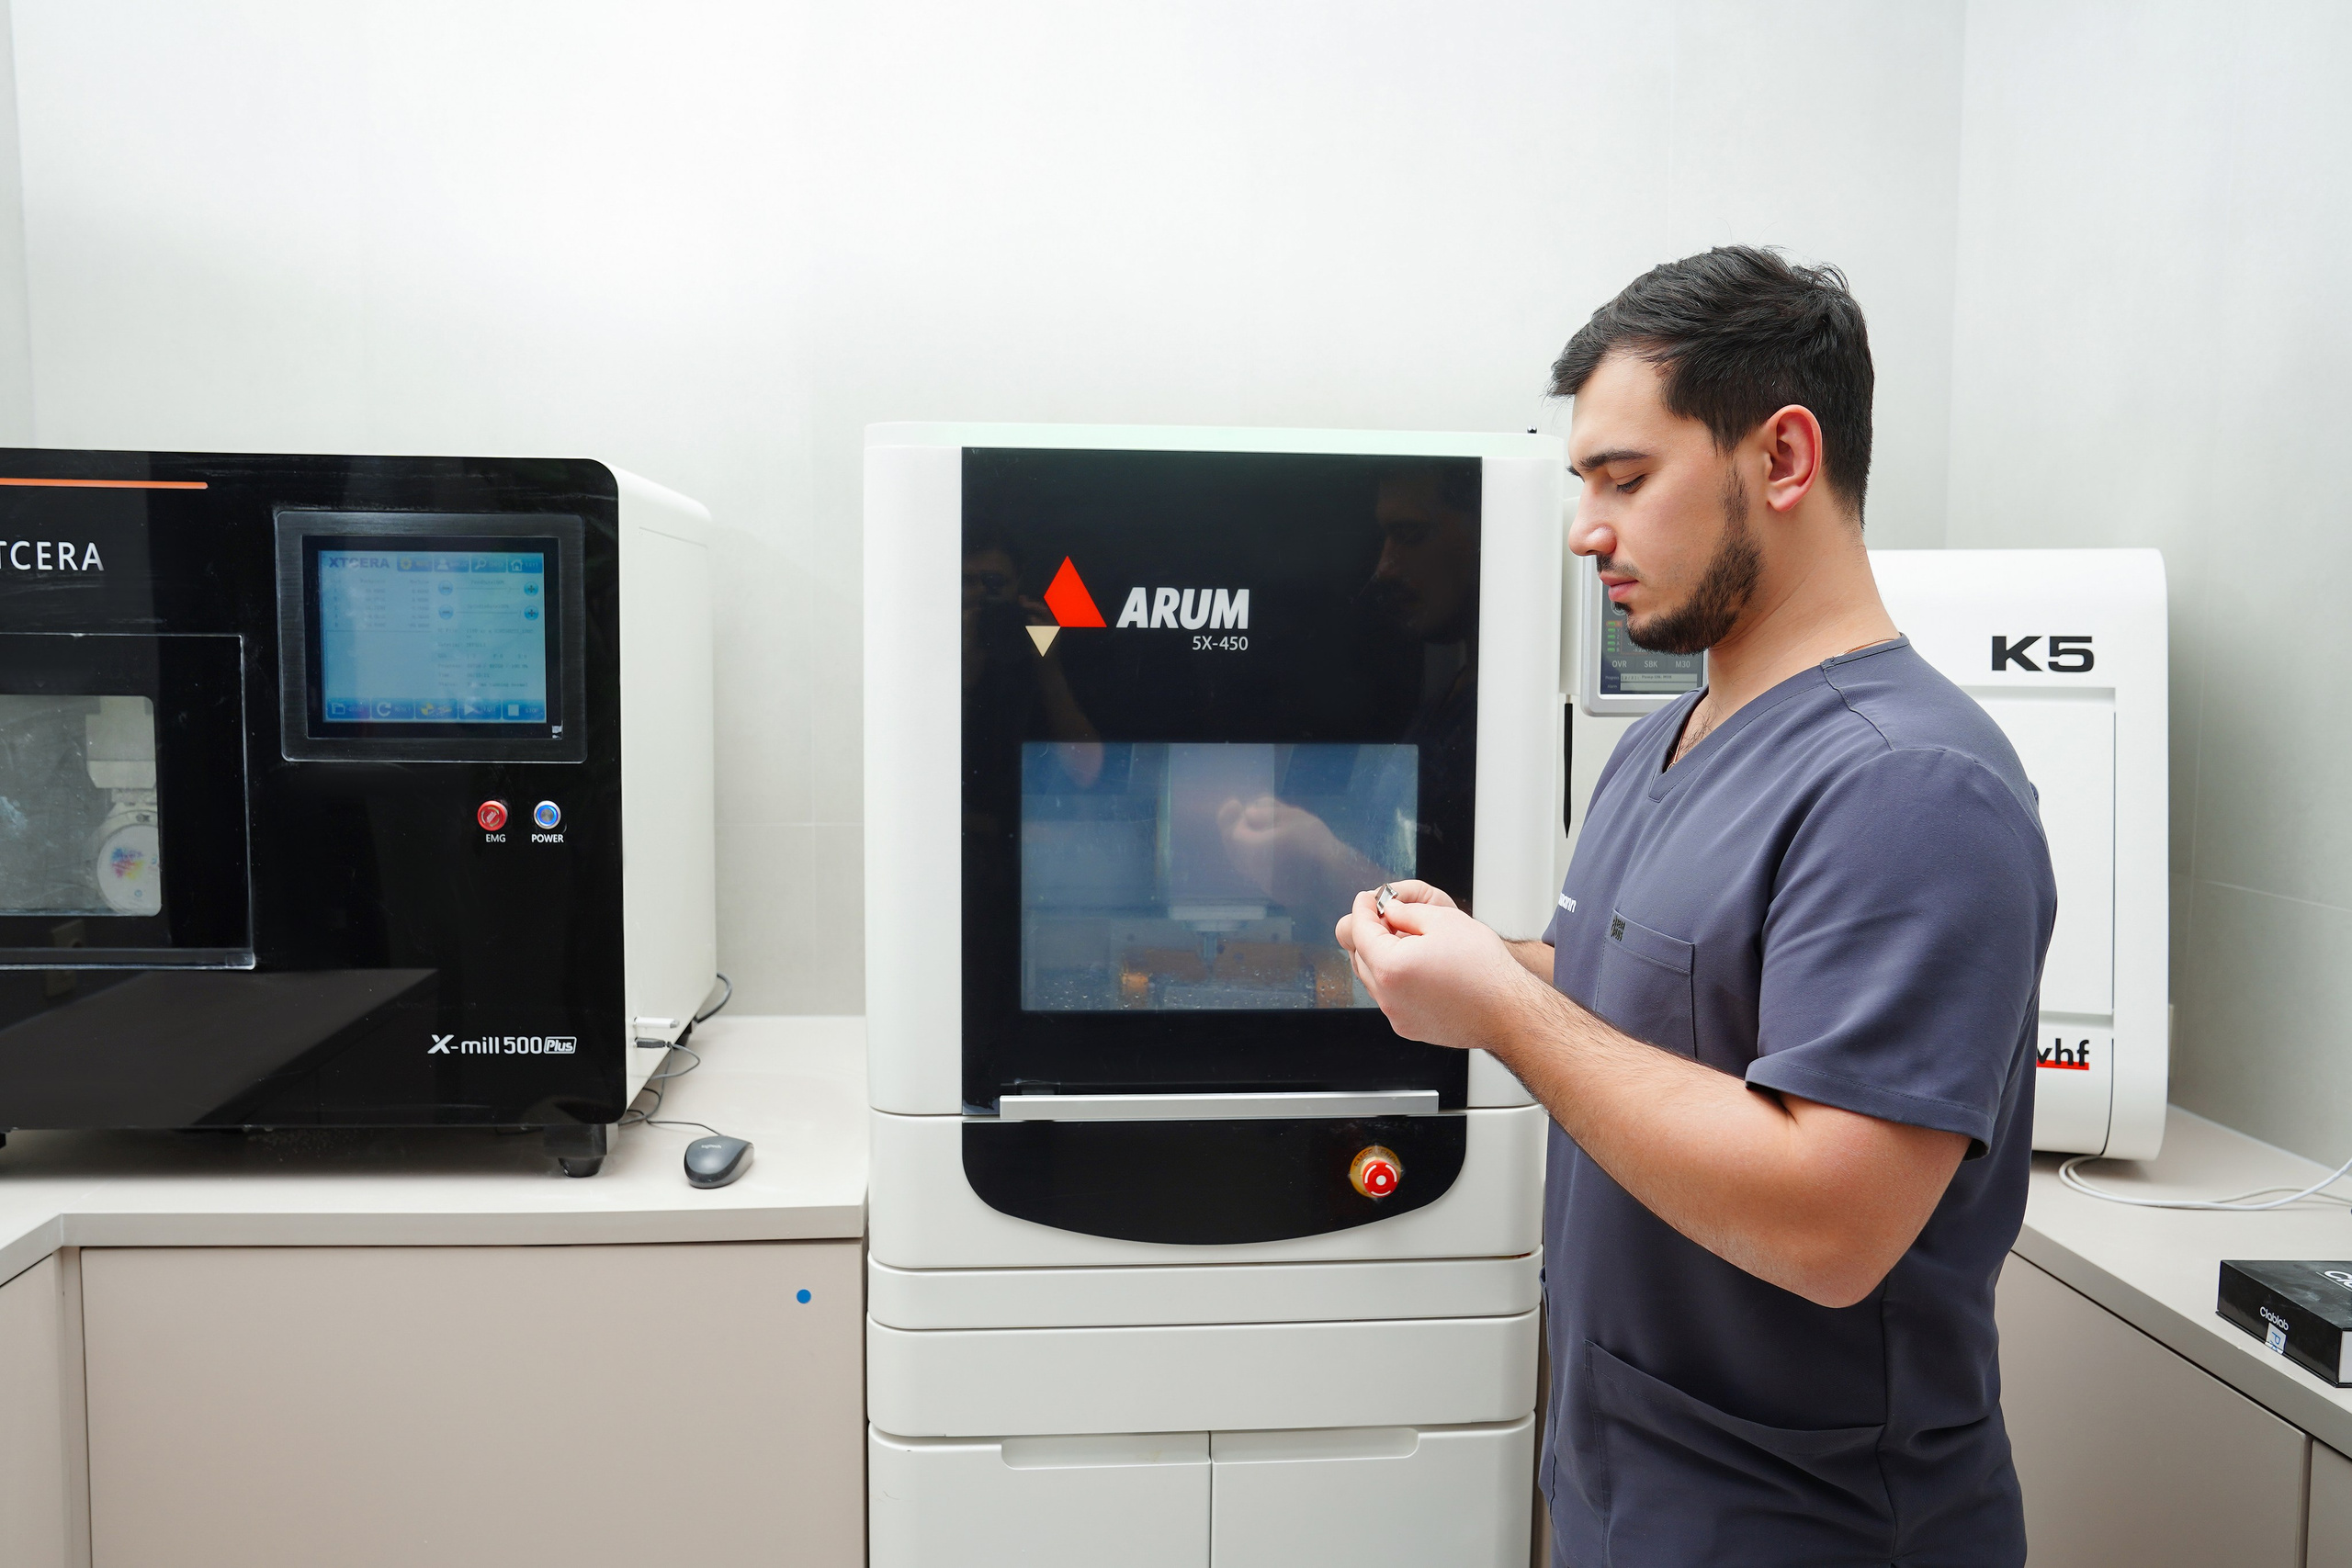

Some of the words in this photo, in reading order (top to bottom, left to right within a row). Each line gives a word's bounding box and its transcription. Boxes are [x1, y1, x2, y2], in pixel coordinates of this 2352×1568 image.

[1115, 587, 1250, 630] ARUM
[1192, 636, 1249, 651] 5X-450
[1992, 636, 2094, 672] K5
[485, 833, 506, 843] EMG
[531, 833, 565, 843] POWER
[427, 1034, 500, 1055] X-mill
[503, 1036, 542, 1055] 500
[546, 1039, 574, 1053] Plus
[2037, 1038, 2089, 1066] vhf
[2259, 1306, 2290, 1331] Clablab
